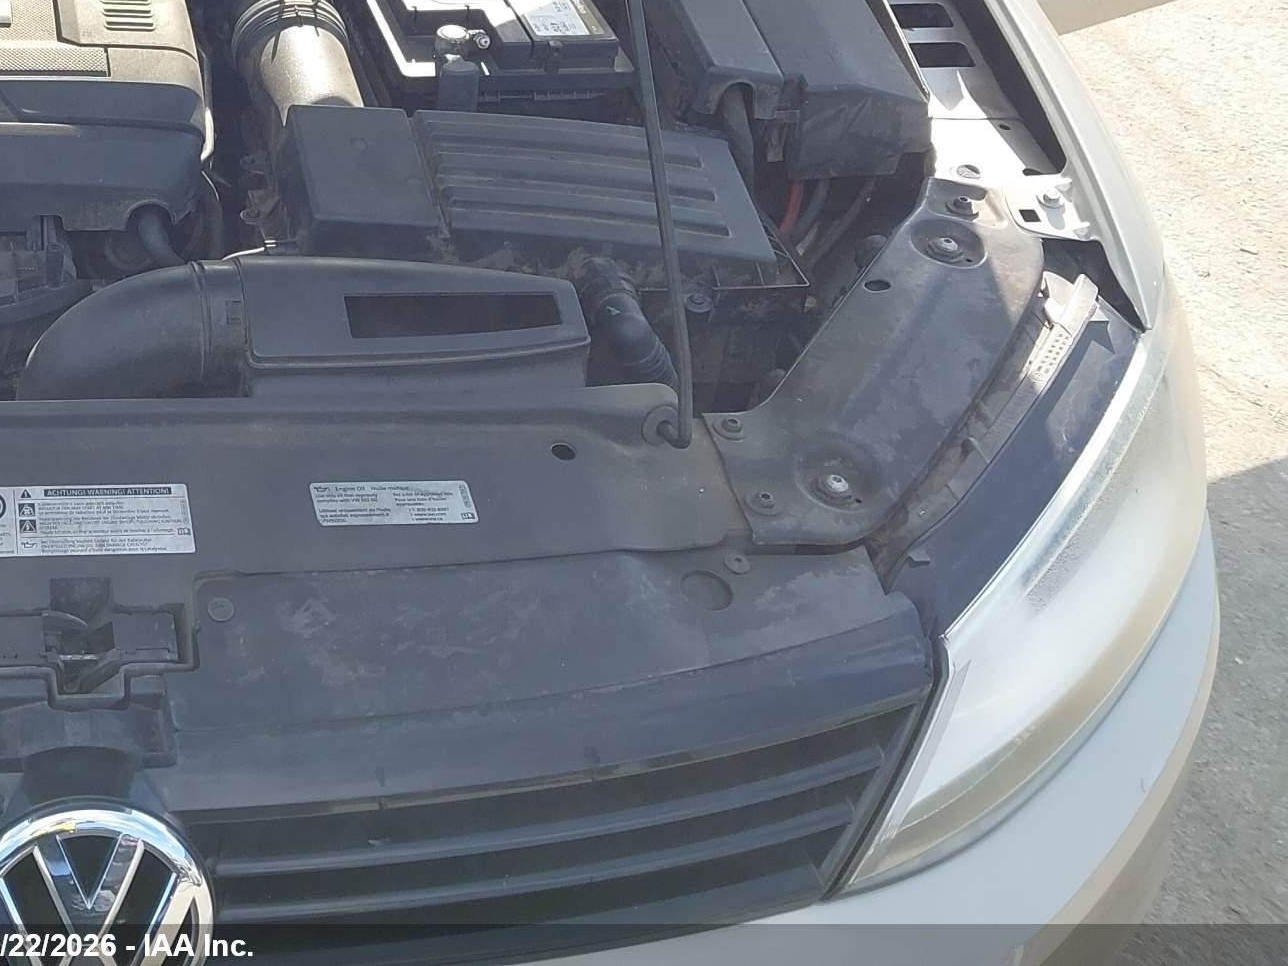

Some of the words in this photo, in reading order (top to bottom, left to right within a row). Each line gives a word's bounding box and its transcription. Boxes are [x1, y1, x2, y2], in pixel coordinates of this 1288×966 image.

[47, 489, 86, 497] ACHTUNG!
[87, 488, 125, 496] WARNING!
[126, 487, 170, 495] ATTENTION!
